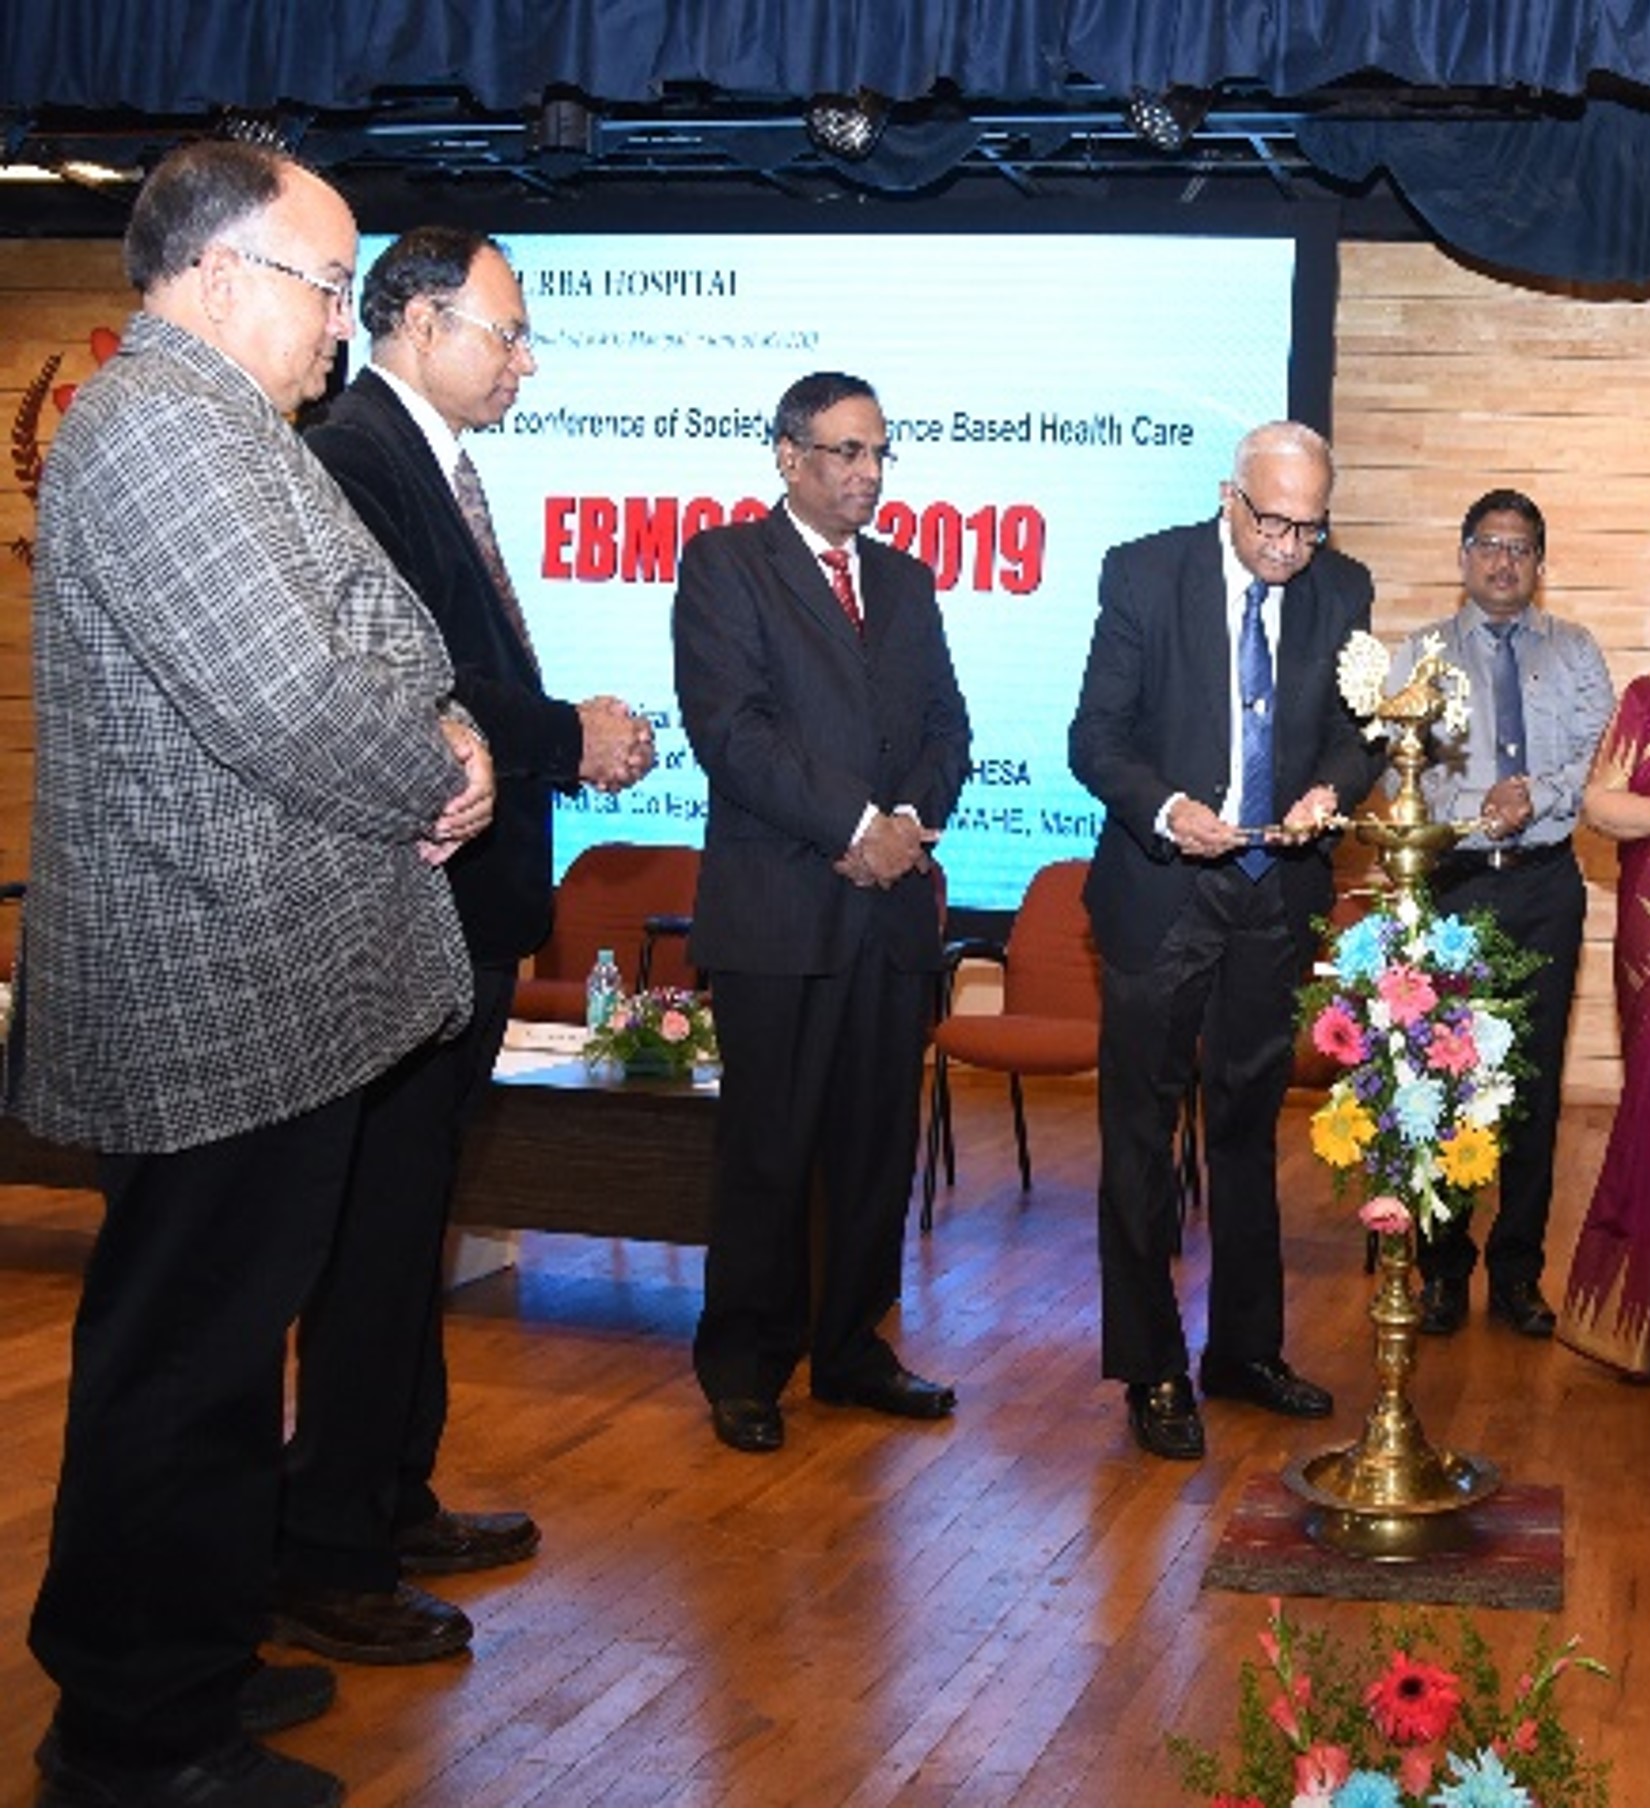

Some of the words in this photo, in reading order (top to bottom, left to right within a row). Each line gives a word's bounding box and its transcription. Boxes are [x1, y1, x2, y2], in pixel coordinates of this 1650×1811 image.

[514, 407, 646, 439] conference
[654, 408, 679, 438] of
[684, 407, 776, 446] Society
[949, 411, 1031, 443] Based
[1040, 412, 1123, 446] Health
[1131, 415, 1195, 447] Care
